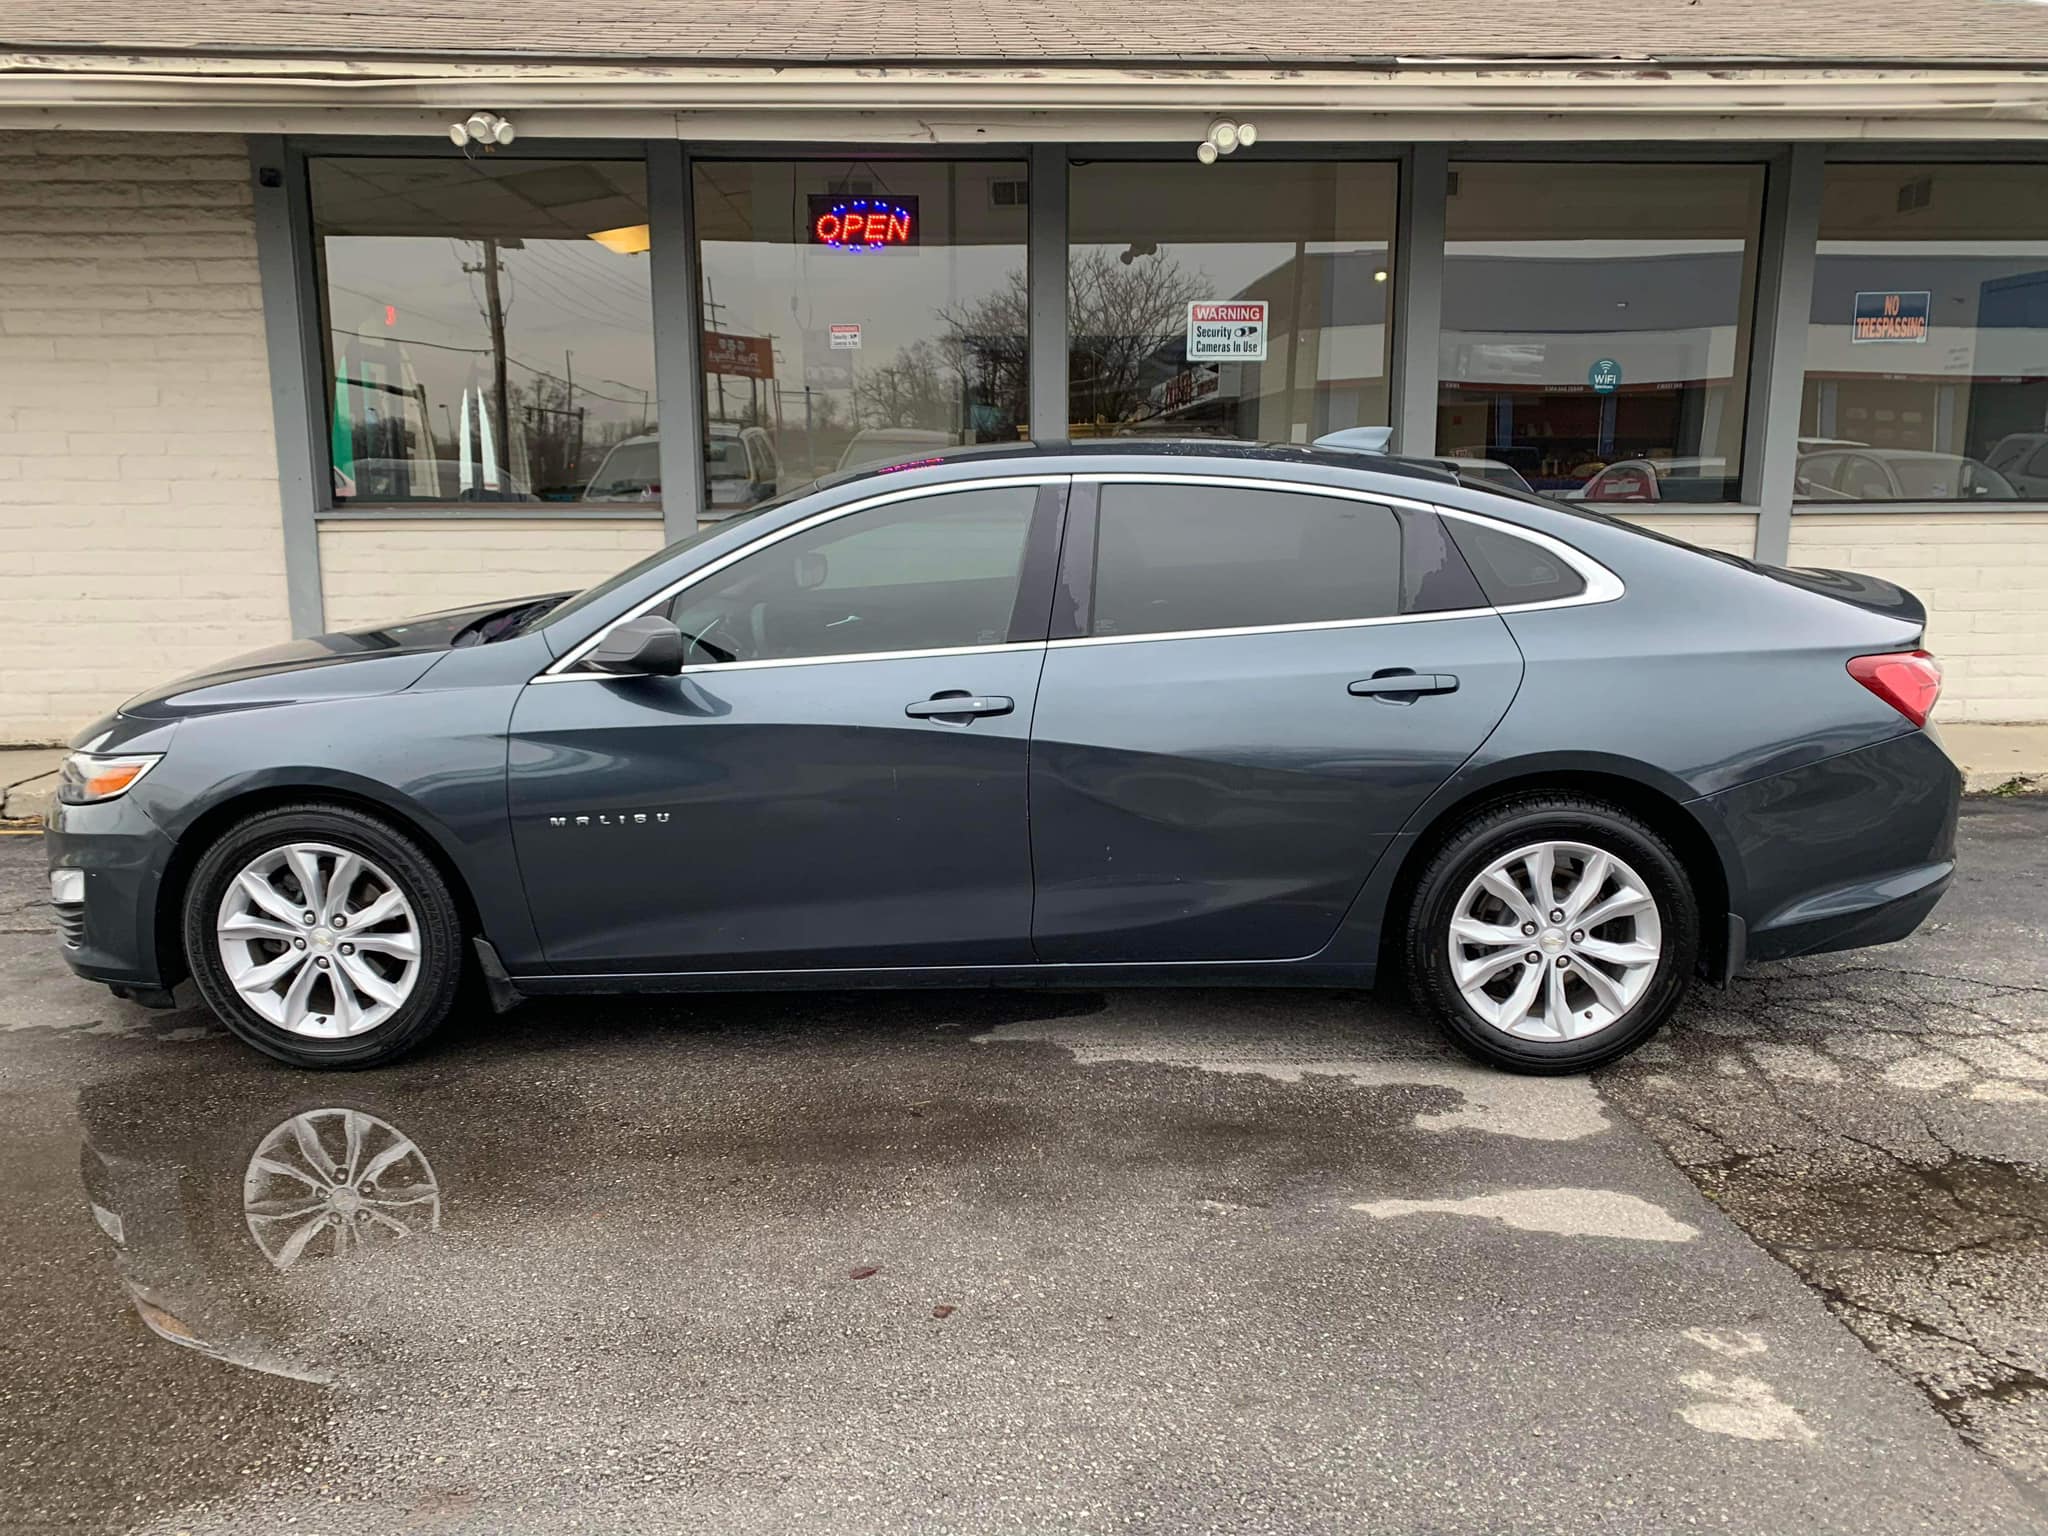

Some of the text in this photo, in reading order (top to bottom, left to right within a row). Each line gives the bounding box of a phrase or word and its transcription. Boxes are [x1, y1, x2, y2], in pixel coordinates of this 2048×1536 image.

[816, 213, 910, 241] OPEN
[1884, 295, 1900, 316] NO
[1196, 307, 1260, 320] WARNING
[1196, 325, 1232, 340] Security
[1857, 317, 1924, 338] TRESPASSING
[1196, 340, 1258, 353] Cameras In Use
[549, 812, 670, 826] MALIBU
